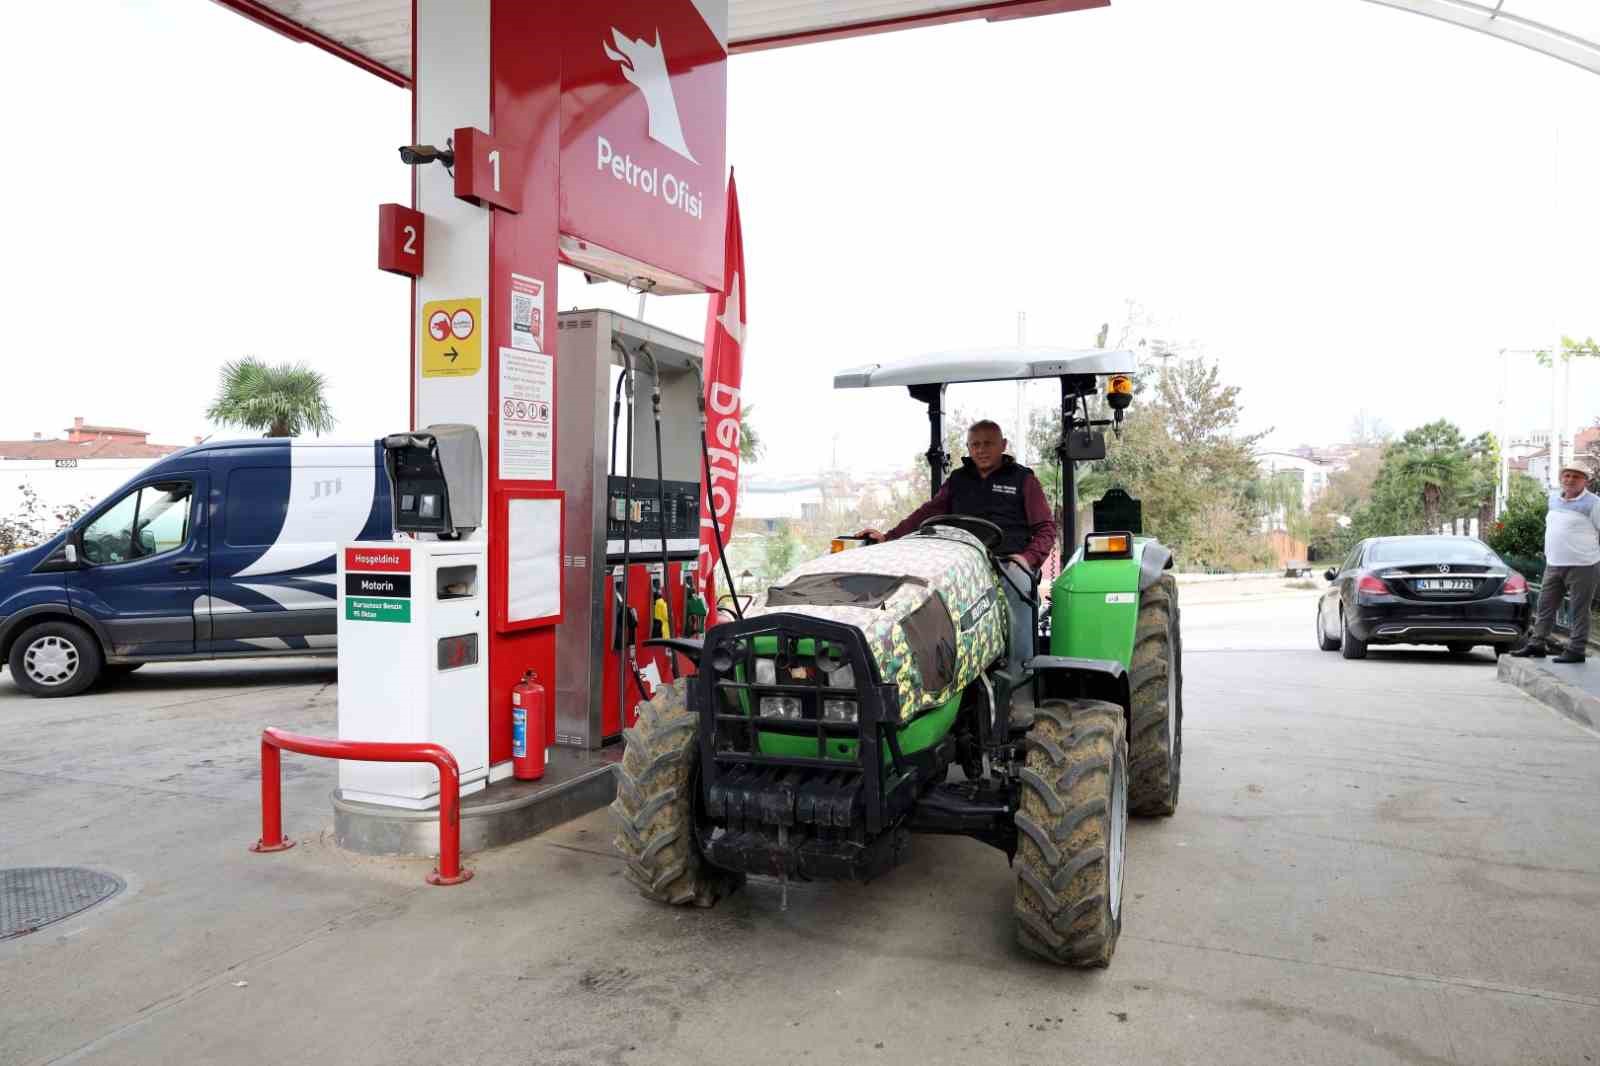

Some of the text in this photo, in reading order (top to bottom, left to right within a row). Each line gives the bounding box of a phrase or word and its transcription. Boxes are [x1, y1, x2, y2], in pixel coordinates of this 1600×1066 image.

[488, 150, 500, 192] 1
[597, 136, 703, 221] Petrol Ofisi
[402, 225, 417, 255] 2
[361, 579, 394, 591] Motorin
